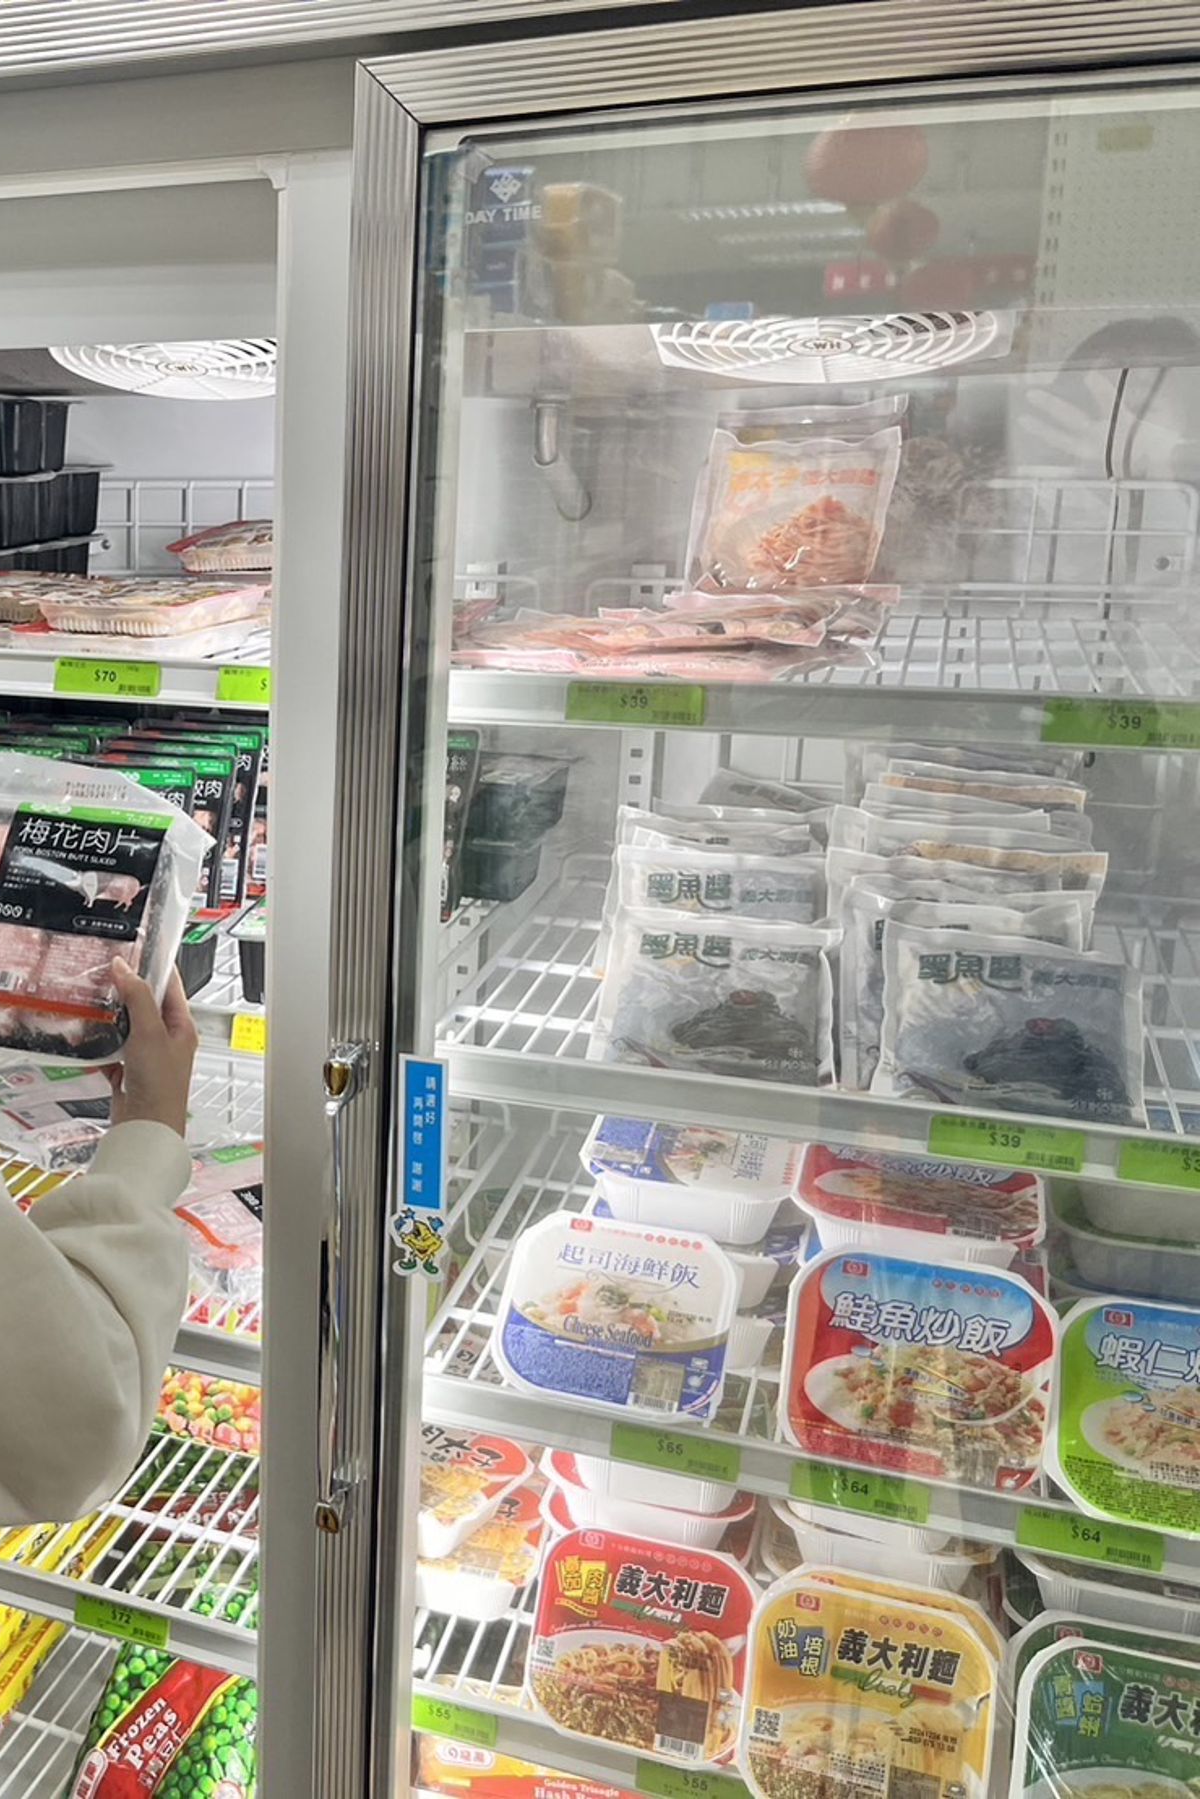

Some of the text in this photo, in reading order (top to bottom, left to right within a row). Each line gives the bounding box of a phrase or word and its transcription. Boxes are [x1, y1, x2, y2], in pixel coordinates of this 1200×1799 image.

[465, 205, 543, 225] DAY TIME
[94, 670, 117, 683] $70
[620, 694, 648, 709] $39
[1108, 714, 1142, 730] $39
[18, 817, 141, 857] 梅花肉片
[989, 1131, 1022, 1148] $39
[558, 1243, 700, 1289] 起司海鮮飯
[563, 1314, 654, 1348] Cheese Seafood
[828, 1291, 1011, 1357] 鮭魚炒飯
[840, 1478, 869, 1496] $64
[1071, 1524, 1100, 1544] $64
[615, 1563, 730, 1618] 義大利麵
[836, 1627, 963, 1686] 義大利麵
[106, 1697, 168, 1762] Frozen
[124, 1708, 178, 1770] Peas
